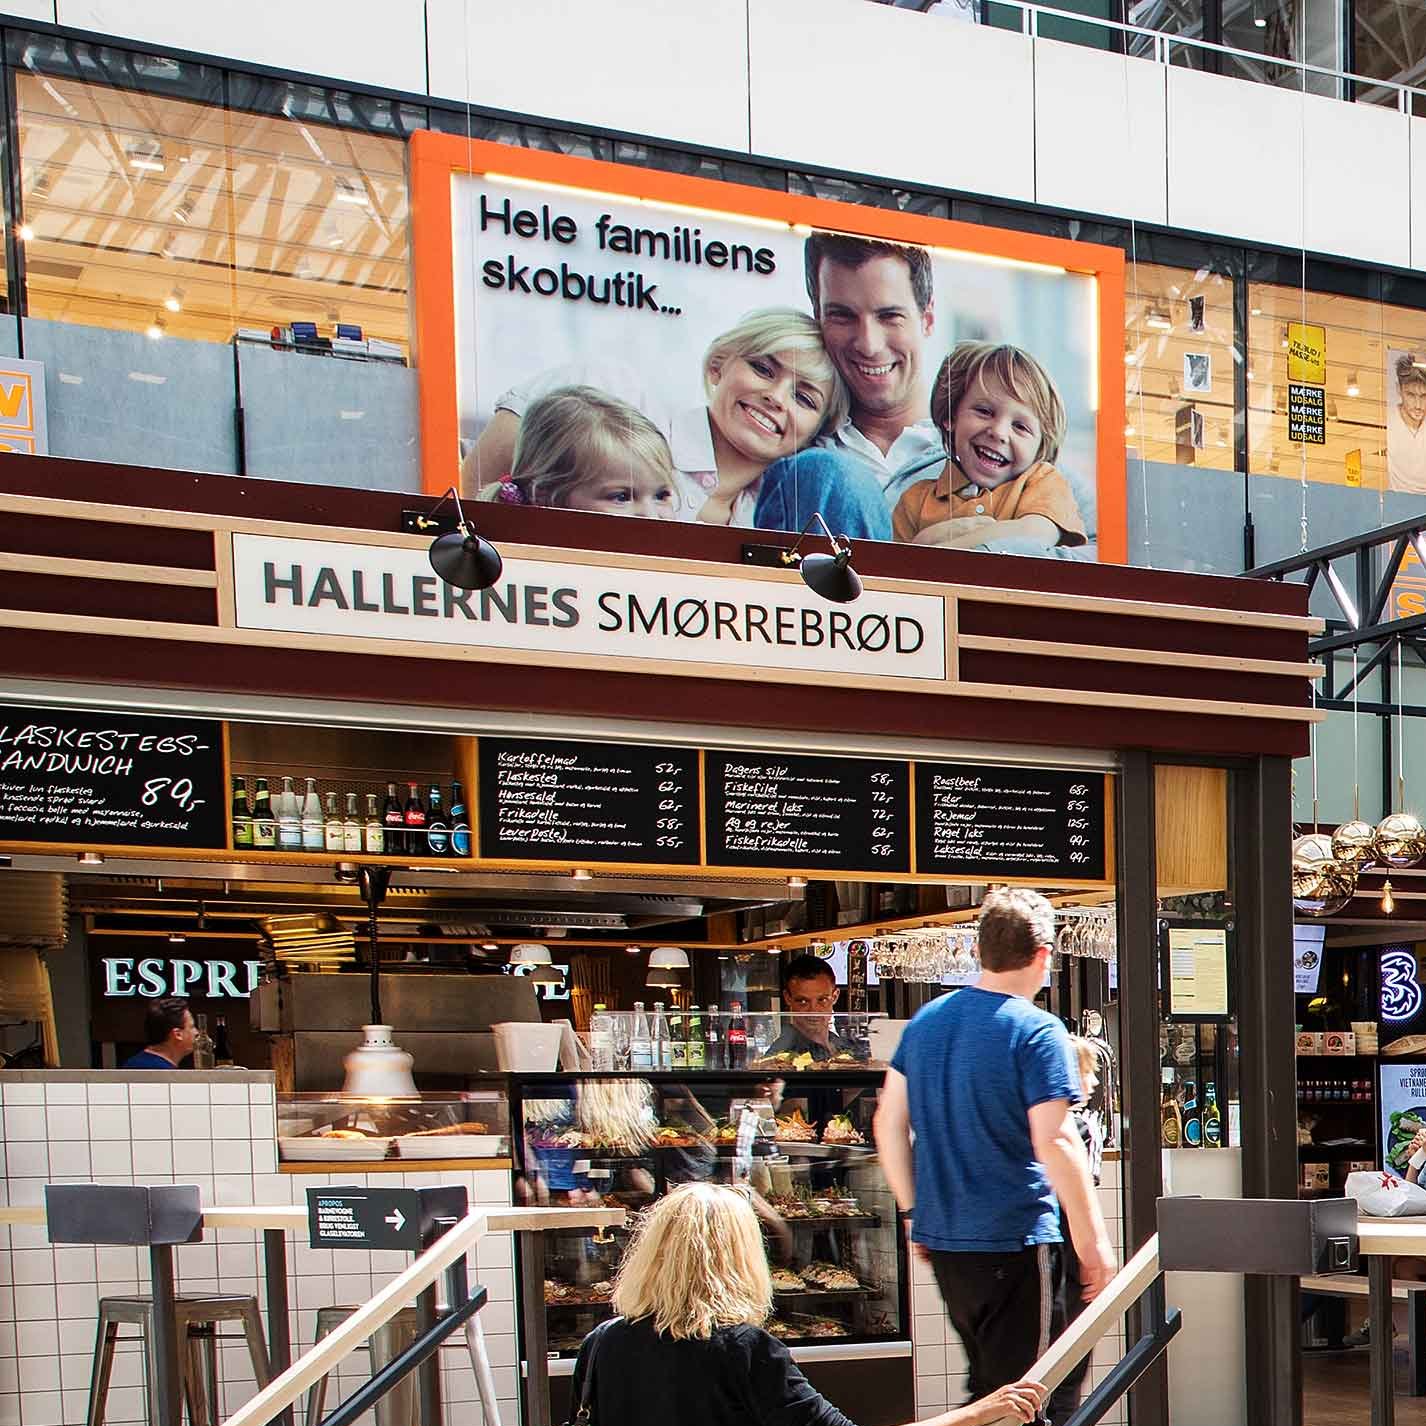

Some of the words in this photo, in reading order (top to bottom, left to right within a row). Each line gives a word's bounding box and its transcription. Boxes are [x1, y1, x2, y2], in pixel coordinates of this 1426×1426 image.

[480, 195, 577, 244] Hele
[595, 214, 776, 275] familiens
[482, 255, 682, 315] skobutik...
[1291, 387, 1323, 398] MÆRKE
[1291, 396, 1323, 406] UDSALG
[1291, 405, 1323, 415] MÆRKE
[1291, 414, 1323, 424] UDSALG
[1291, 424, 1323, 435] MÆRKE
[1292, 433, 1323, 442] UDSALG
[264, 561, 580, 628] HALLERNES
[598, 592, 924, 654] SMØRREBRØD
[0, 750, 133, 775] ANDWICH
[498, 752, 578, 766] Kartoffelmad
[724, 763, 762, 776] Dagens
[766, 766, 788, 776] sild
[933, 775, 981, 788] Roastbeef
[724, 782, 778, 794] Fiskefilet
[933, 793, 962, 803] Tatar
[70, 807, 89, 815] med
[724, 801, 778, 813] Marineret
[783, 802, 804, 813] laks
[498, 808, 559, 820] Frikadelle
[933, 810, 977, 822] Rejemad
[745, 818, 757, 829] og
[964, 828, 984, 838] laks
[725, 835, 808, 848] Fiskefrikadelle
[934, 845, 982, 856] Laksesalat
